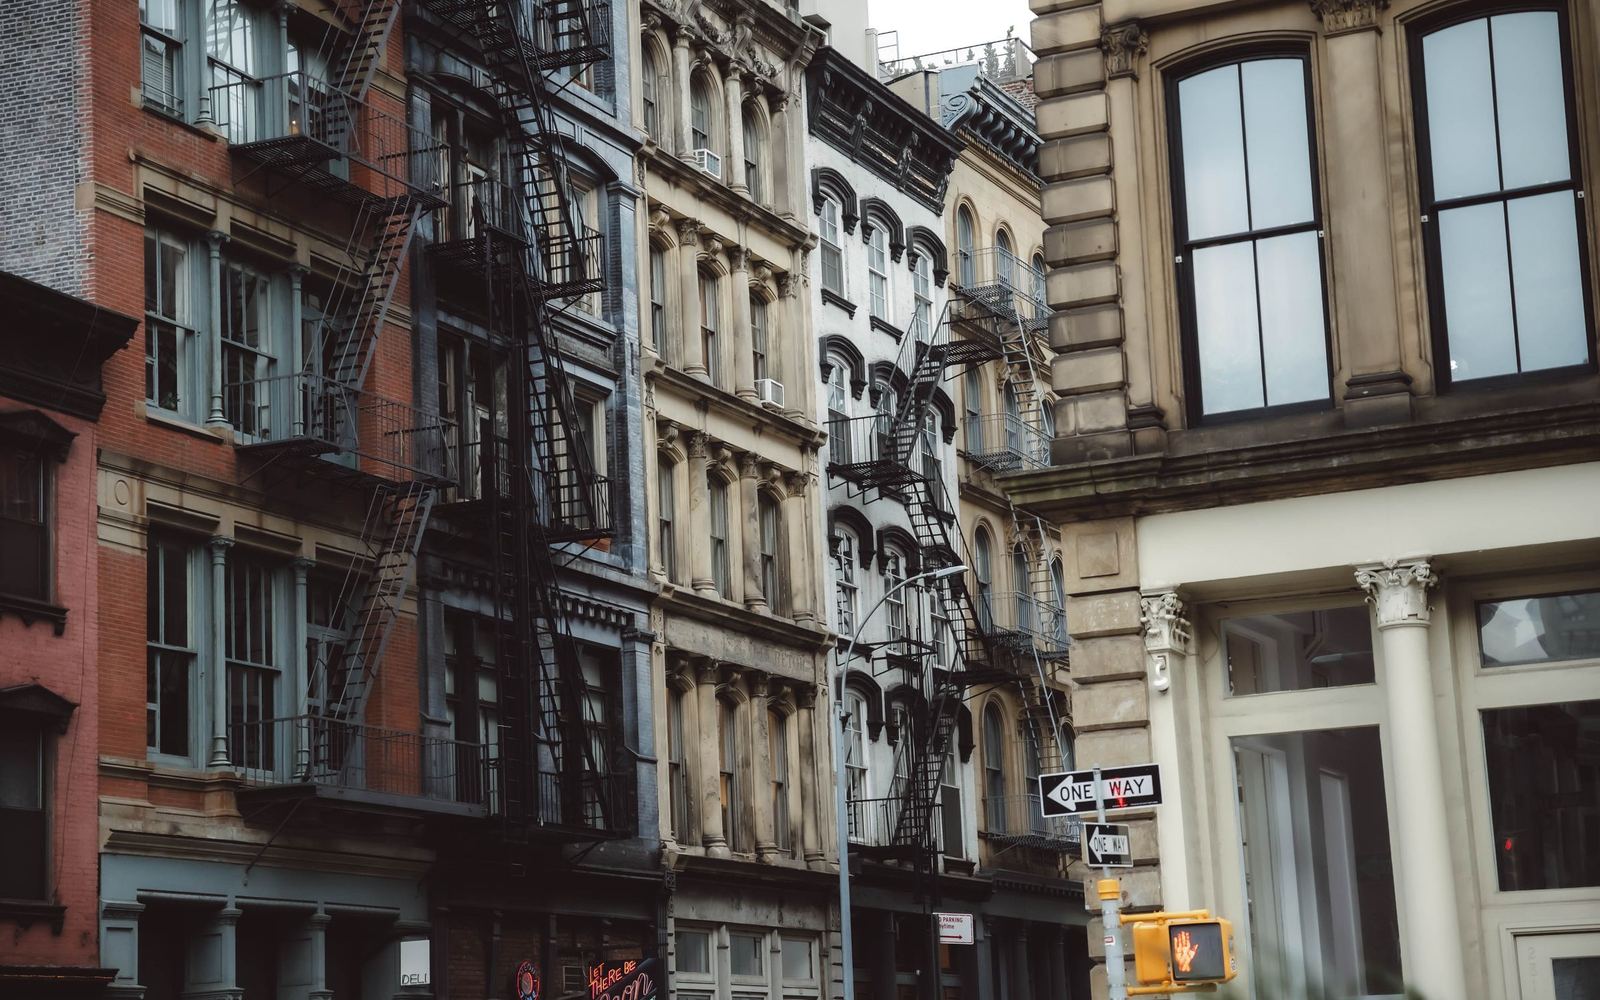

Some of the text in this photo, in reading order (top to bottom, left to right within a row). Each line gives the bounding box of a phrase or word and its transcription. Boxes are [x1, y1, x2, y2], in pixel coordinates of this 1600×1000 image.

[1060, 778, 1144, 801] ONE WAY
[1094, 836, 1125, 852] ONE WAY
[402, 973, 427, 984] DELI
[588, 960, 636, 1000] THERE BE
[589, 963, 604, 983] LET
